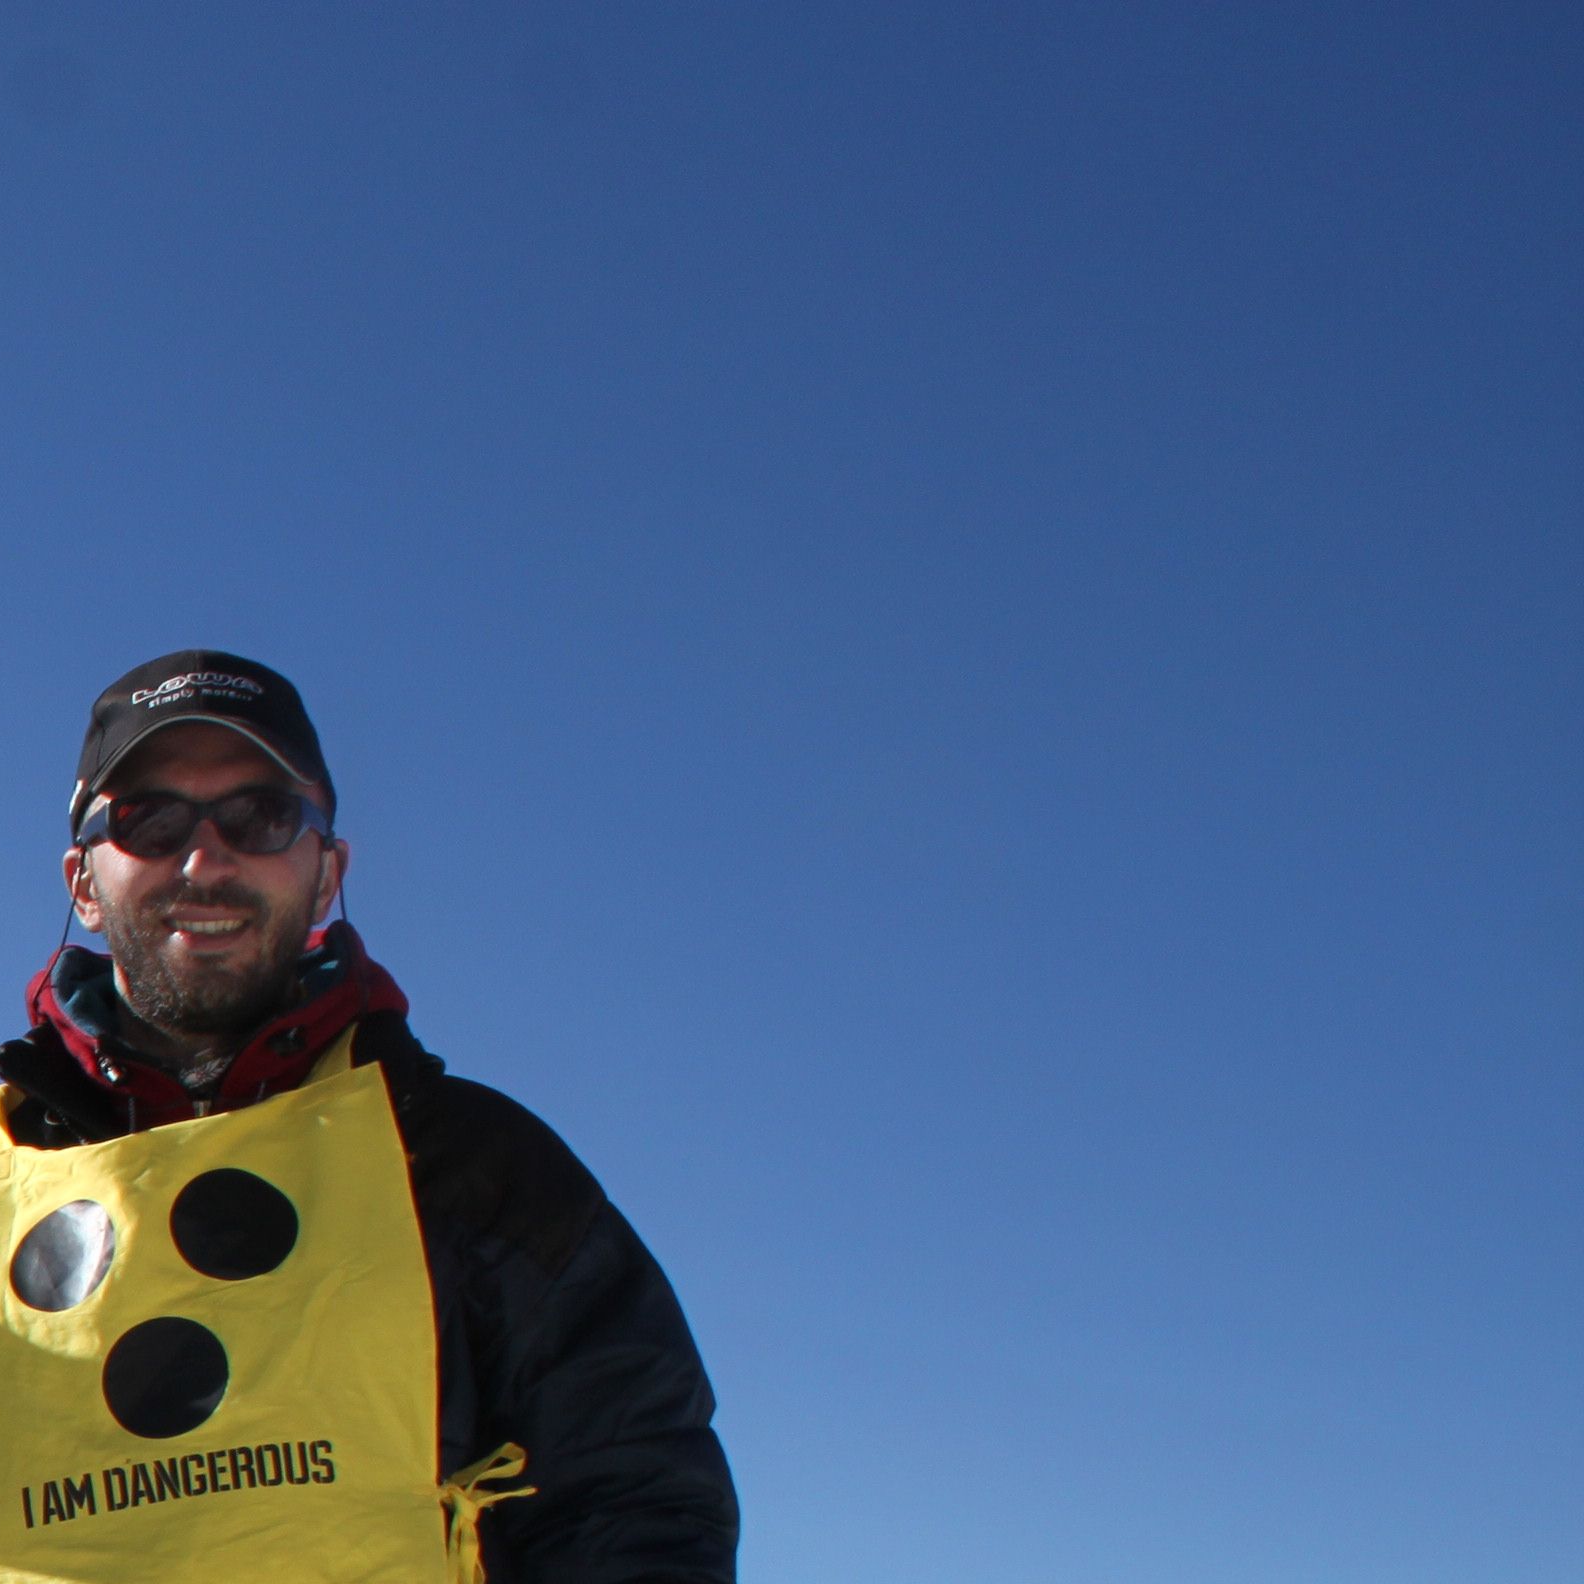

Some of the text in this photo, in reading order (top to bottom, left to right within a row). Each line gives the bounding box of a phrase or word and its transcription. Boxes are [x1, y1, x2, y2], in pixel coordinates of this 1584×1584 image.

[148, 687, 195, 709] simply
[20, 1439, 337, 1530] I AM DANGEROUS
